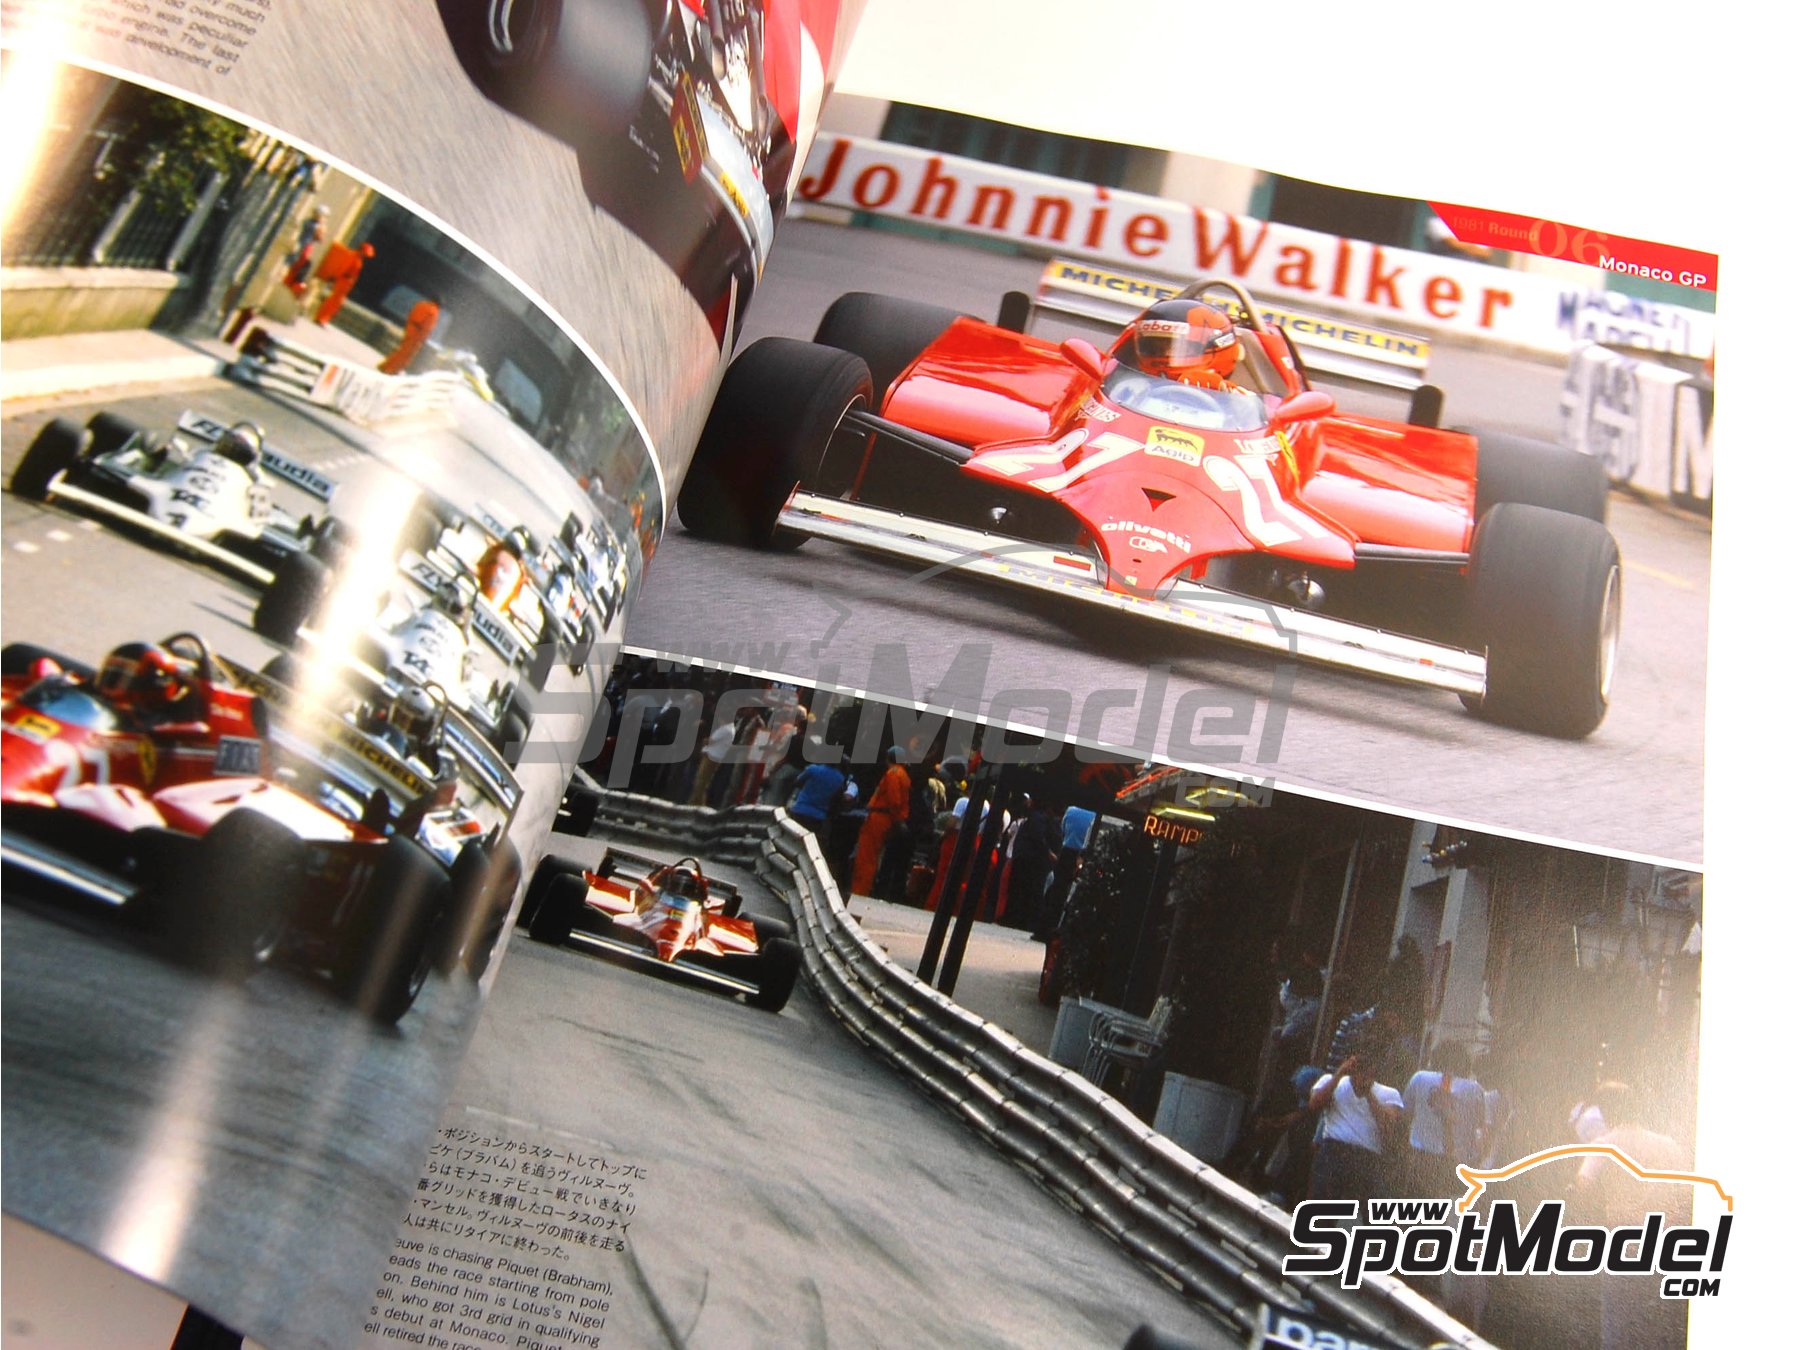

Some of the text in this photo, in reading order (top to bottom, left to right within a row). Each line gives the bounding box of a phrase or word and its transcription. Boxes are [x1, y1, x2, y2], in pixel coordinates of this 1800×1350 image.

[798, 137, 1170, 258] Johnnie
[1191, 205, 1515, 331] Walker
[1452, 217, 1612, 267] 1981 Round 06
[1599, 254, 1708, 288] Monaco GP
[1151, 445, 1195, 463] Agip
[1202, 454, 1329, 548] 27
[1101, 516, 1192, 554] olivetti
[388, 1254, 610, 1313] eads the race starting from pole
[428, 1242, 441, 1256] is
[442, 1247, 495, 1271] chasing
[497, 1257, 540, 1280] Piquet
[376, 1287, 601, 1350] ell, who got 3rd grid in qualifying
[383, 1271, 606, 1330] on. Behind him is Lotus's Nigel
[364, 1322, 382, 1335] ell
[382, 1326, 426, 1345] retired
[427, 1334, 449, 1349] the
[384, 1306, 424, 1326] debut
[429, 1318, 444, 1330] at
[449, 1320, 509, 1345] Monaco.
[516, 1335, 563, 1350] Piquet
